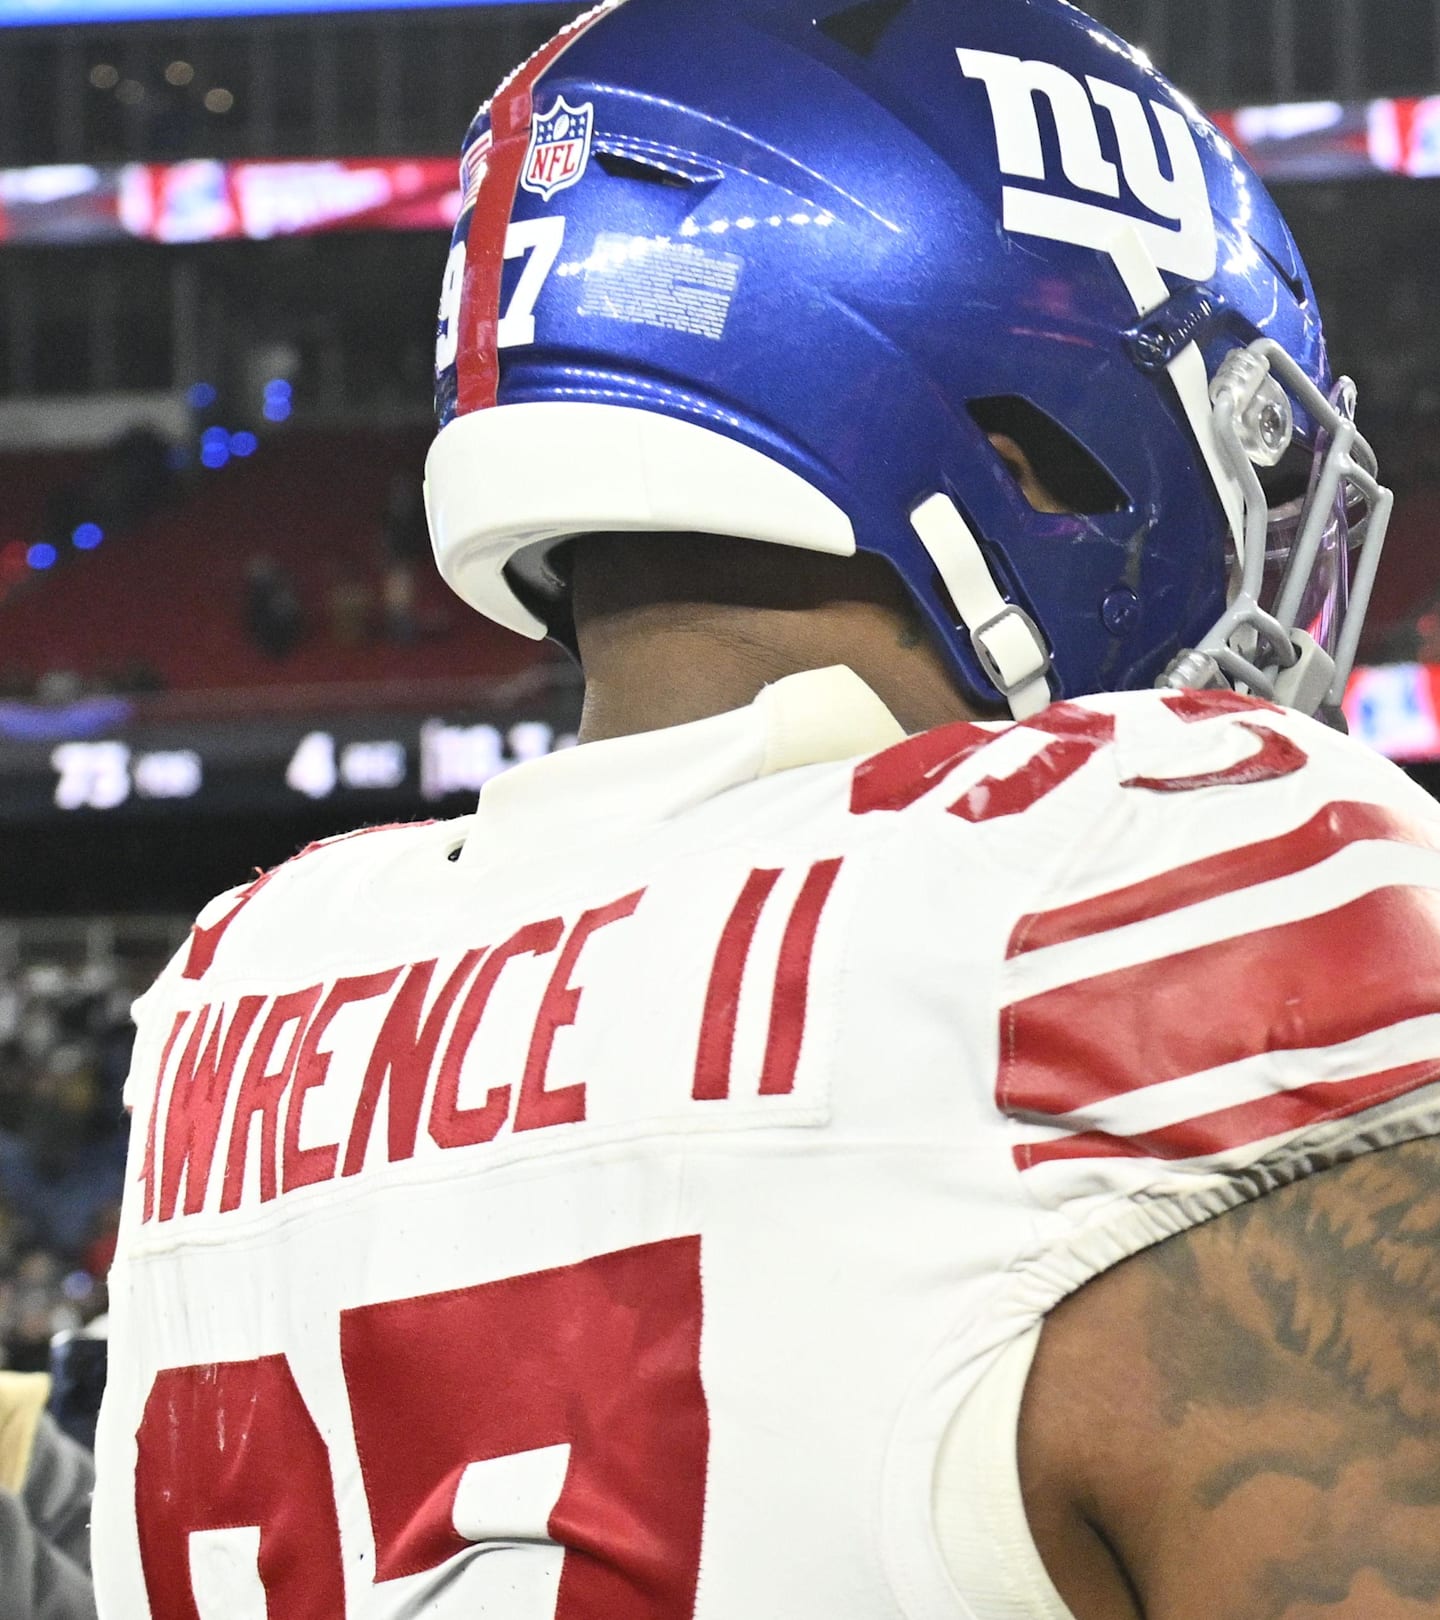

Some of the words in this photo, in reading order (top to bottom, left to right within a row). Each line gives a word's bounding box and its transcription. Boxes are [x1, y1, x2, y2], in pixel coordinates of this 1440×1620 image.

[530, 142, 576, 183] NFL
[955, 47, 1218, 282] ny
[692, 855, 844, 1101] II
